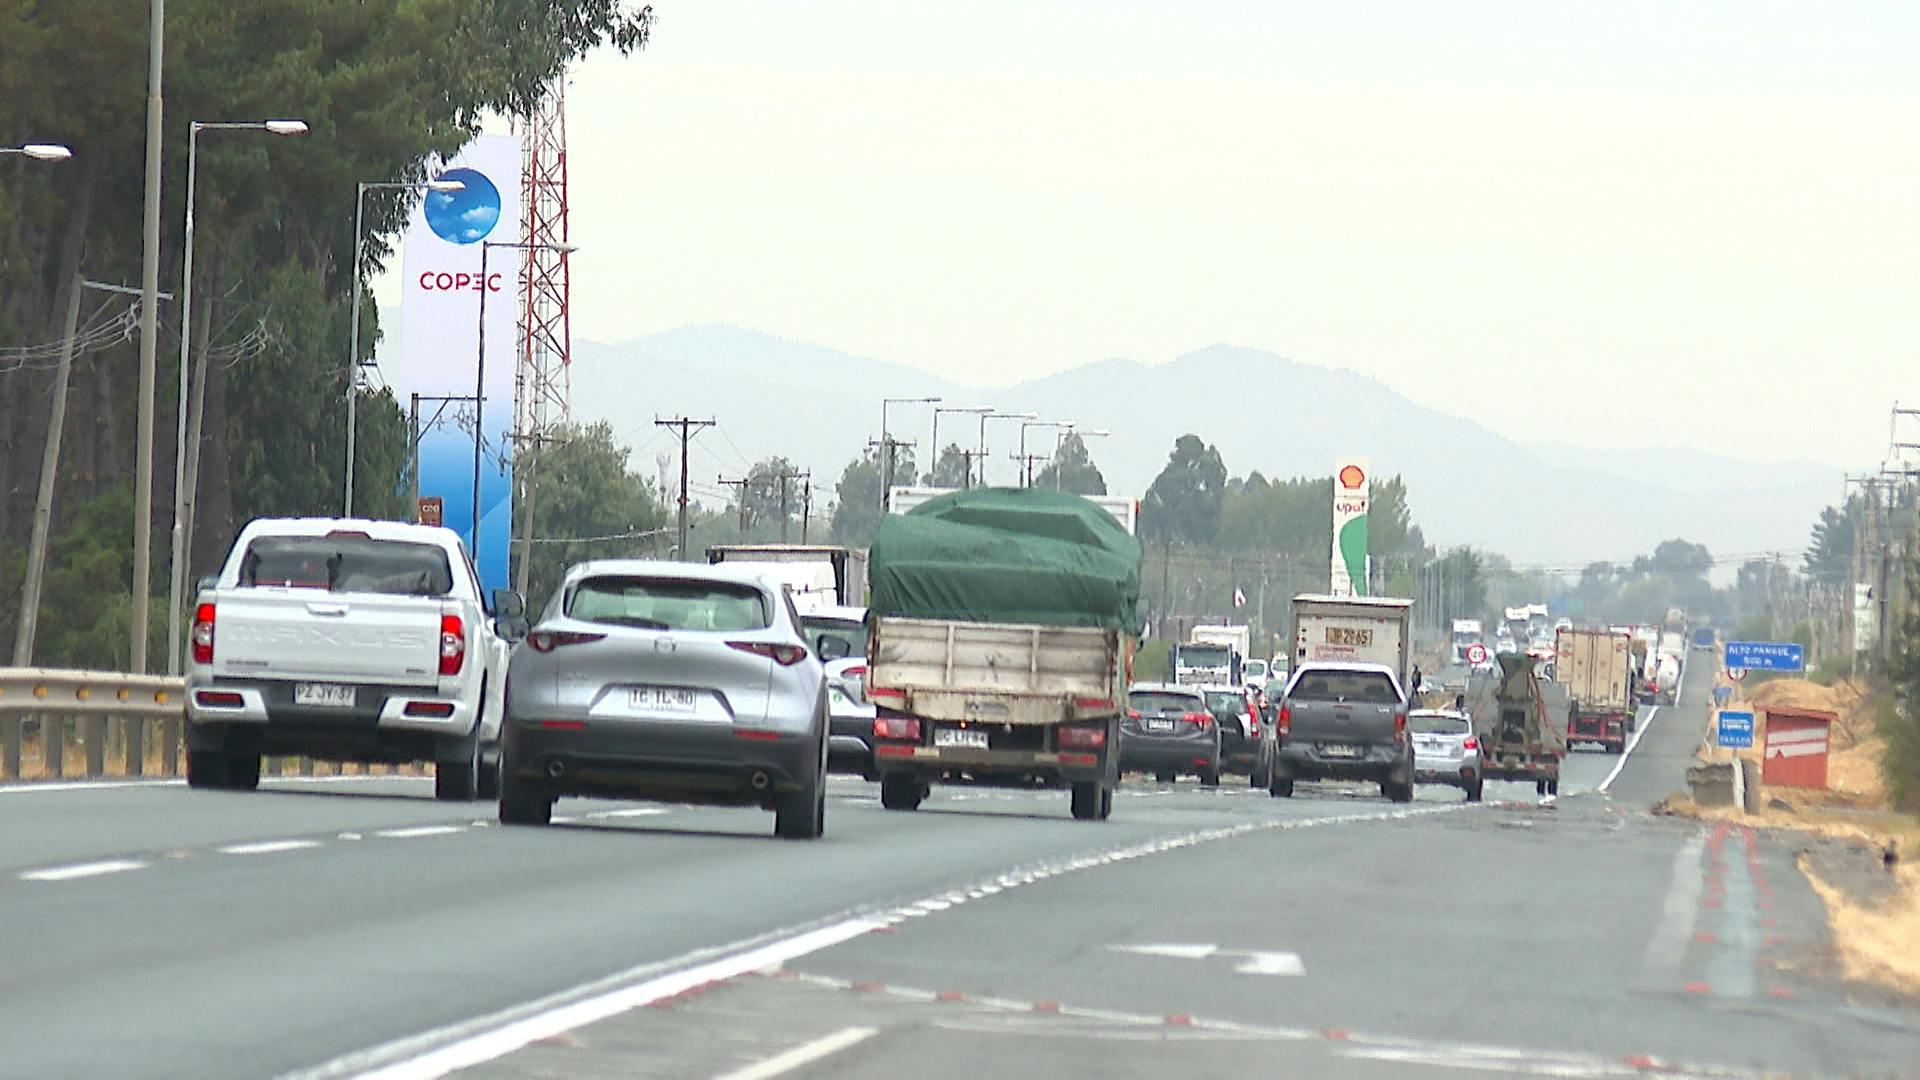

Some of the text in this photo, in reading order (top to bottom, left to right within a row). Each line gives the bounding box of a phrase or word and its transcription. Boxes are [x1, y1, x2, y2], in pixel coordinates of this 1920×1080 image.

[419, 271, 502, 292] COPEC
[227, 624, 427, 650] MAXUS
[1728, 645, 1790, 657] ALTO PANGUE
